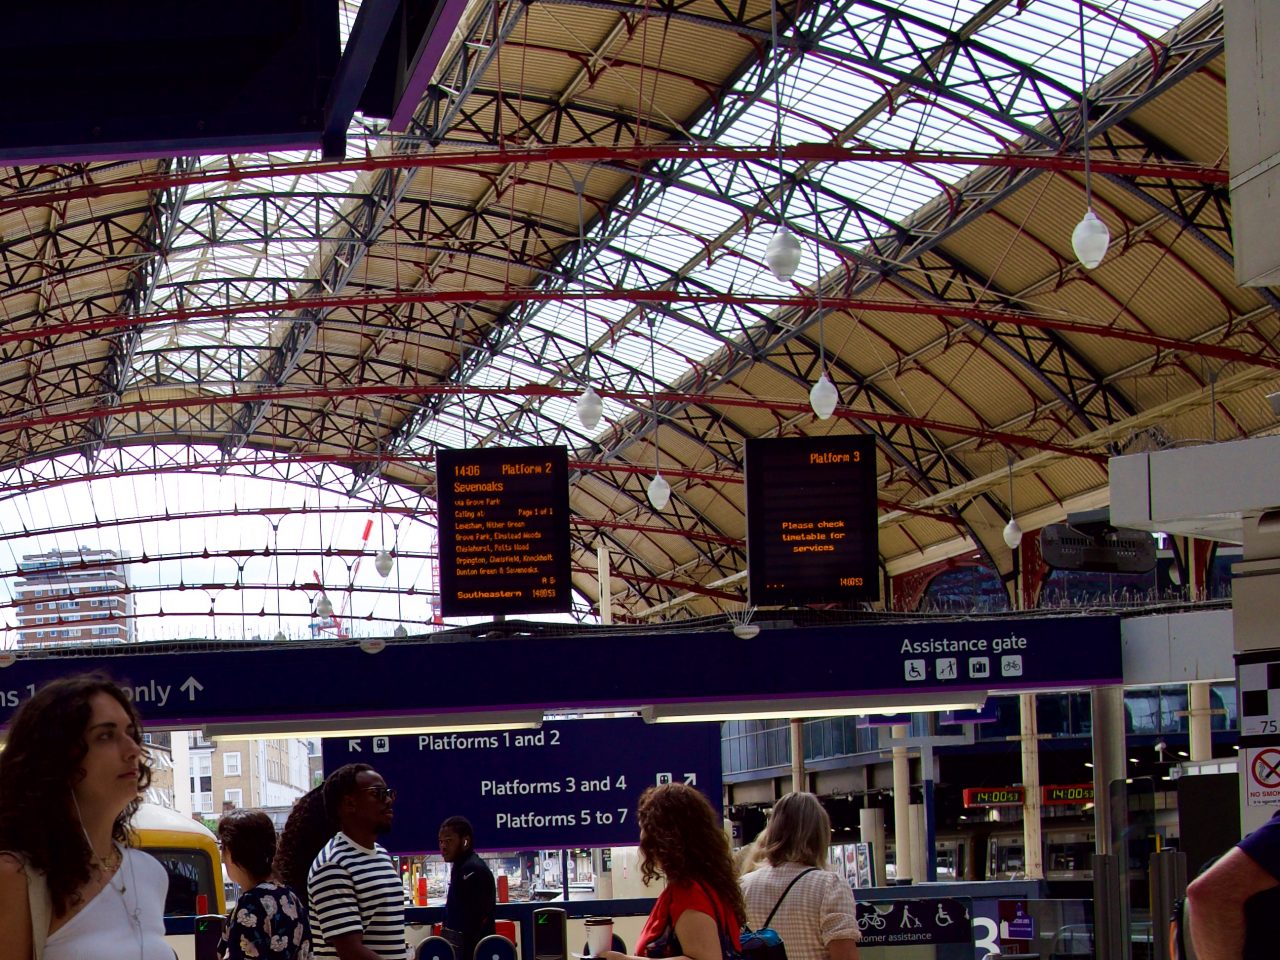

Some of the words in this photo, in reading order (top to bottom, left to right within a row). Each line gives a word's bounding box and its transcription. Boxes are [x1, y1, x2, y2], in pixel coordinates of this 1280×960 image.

[810, 453, 849, 464] Platform
[854, 452, 860, 462] 3
[455, 466, 480, 476] 14:06
[502, 464, 542, 475] Platform
[546, 463, 552, 473] 2
[454, 482, 503, 492] Sevenoaks
[518, 509, 532, 517] Page
[793, 544, 834, 552] services
[458, 591, 522, 599] Southeastern
[901, 639, 987, 653] Assistance
[992, 636, 1027, 653] gate
[121, 680, 171, 706] only
[1260, 721, 1277, 733] 75
[419, 735, 498, 750] Platforms
[503, 733, 510, 746] 1
[515, 731, 544, 746] and
[551, 730, 560, 744] 2
[482, 780, 560, 795] Platforms
[566, 777, 575, 792] 3
[581, 776, 610, 791] and
[616, 776, 627, 789] 4
[497, 813, 575, 828] Platforms
[581, 810, 590, 824] 5
[596, 811, 613, 824] to
[618, 809, 627, 823] 7
[856, 934, 886, 942] stomer
[889, 932, 932, 942] assistance
[973, 917, 1000, 960] 3
